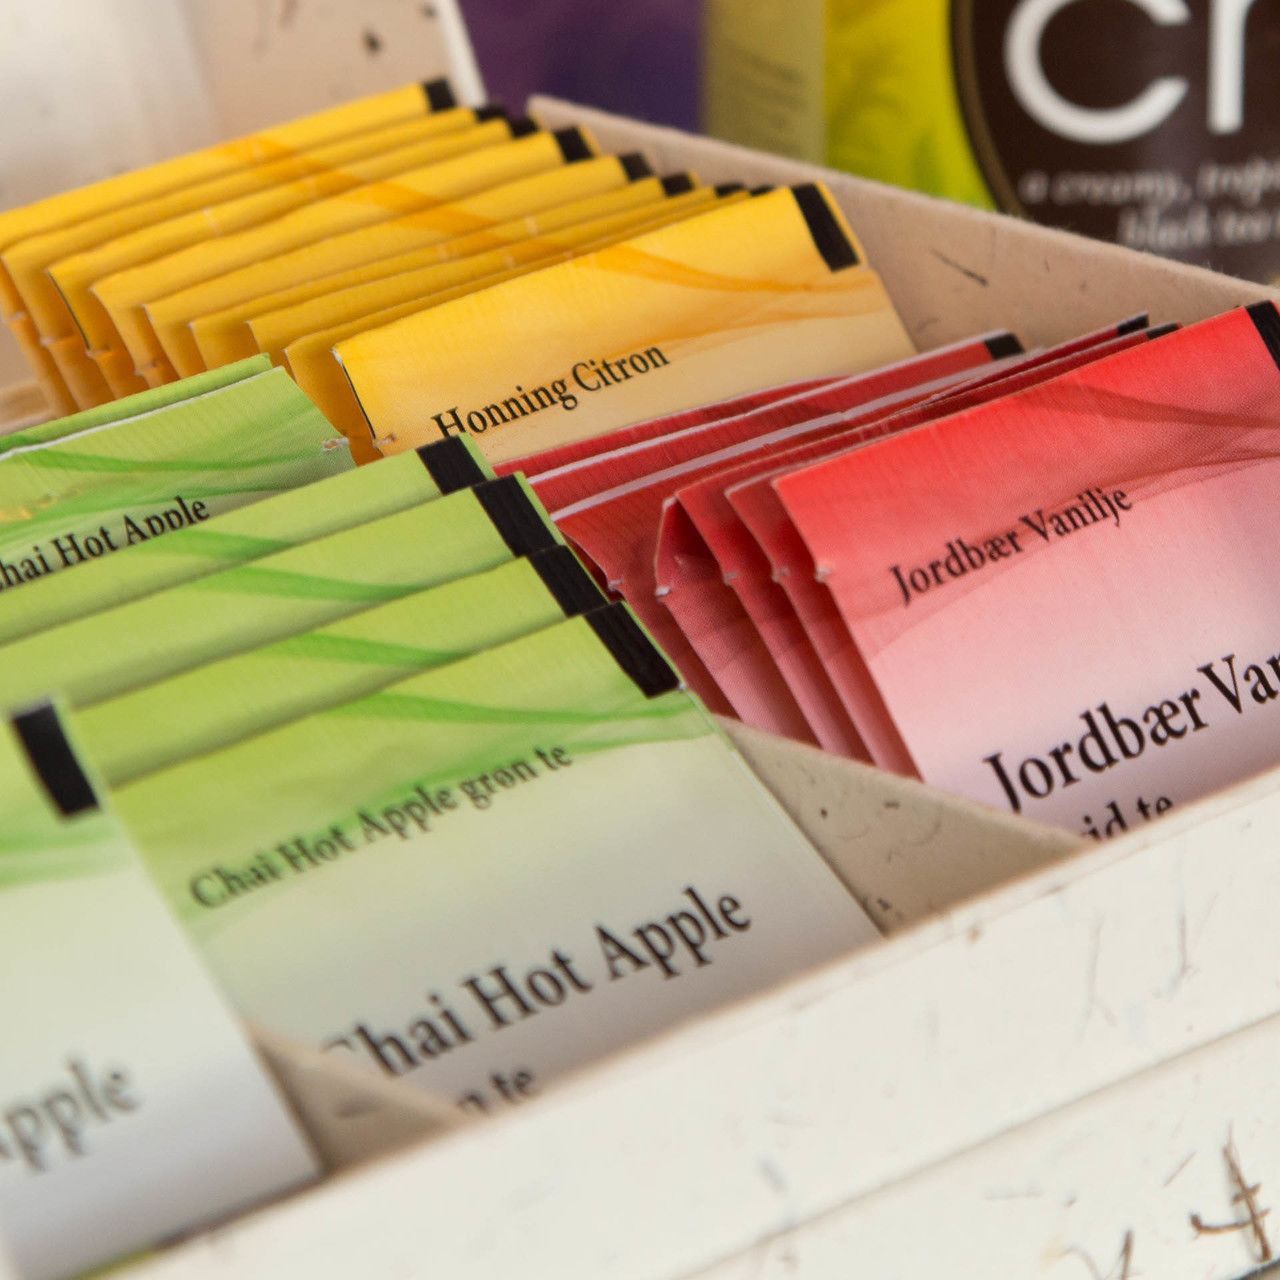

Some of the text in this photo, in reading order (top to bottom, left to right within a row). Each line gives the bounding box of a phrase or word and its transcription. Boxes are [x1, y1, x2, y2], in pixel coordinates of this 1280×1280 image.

[431, 345, 671, 439] Honning Citron
[51, 525, 120, 569] Hot
[121, 494, 211, 548] Apple
[888, 483, 1134, 606] Jordbær Vanilje
[981, 686, 1209, 815] Jordbær
[189, 837, 284, 909] Chai
[277, 823, 358, 880] Hot
[357, 782, 458, 841] Apple
[534, 742, 574, 773] te
[322, 885, 753, 1079] hai Hot Apple
